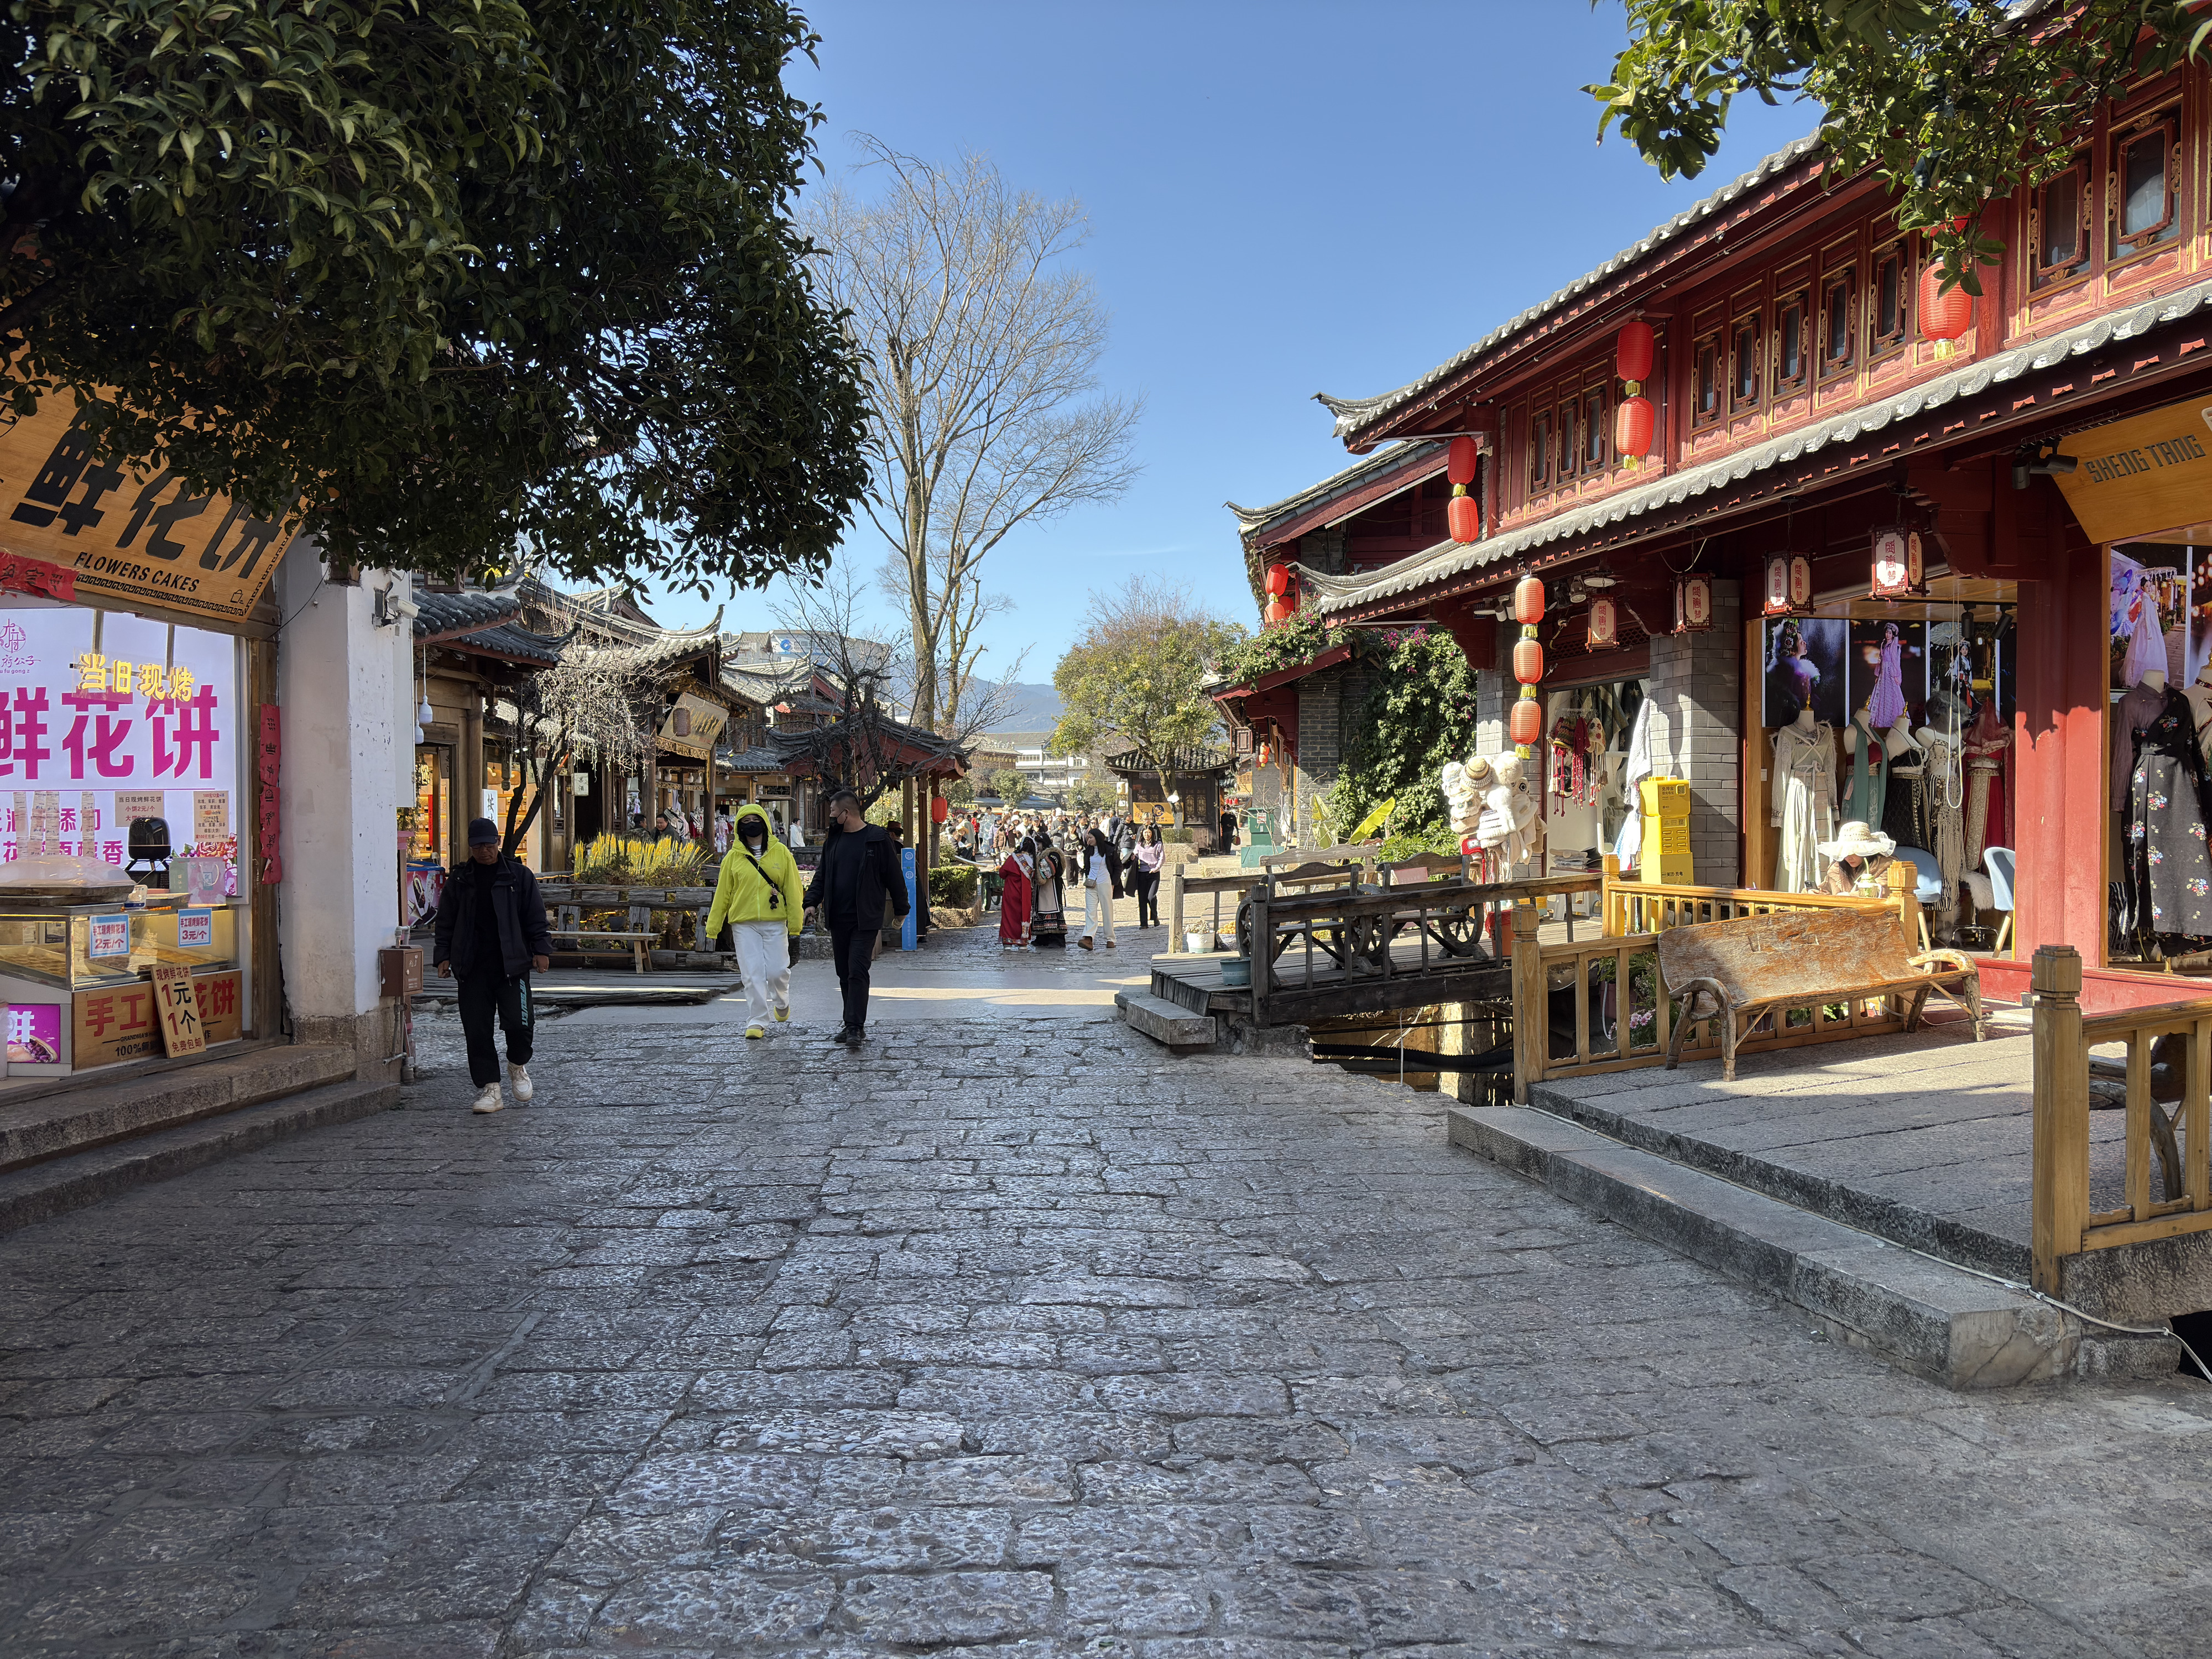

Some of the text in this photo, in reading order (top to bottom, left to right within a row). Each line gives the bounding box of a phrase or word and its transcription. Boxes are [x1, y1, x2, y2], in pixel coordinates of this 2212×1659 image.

[2084, 434, 2206, 483] SHENG TANG
[74, 551, 150, 581] FLOWERS
[152, 570, 200, 592] CAKES
[79, 653, 195, 702] 当日现烤
[0, 685, 220, 779] 鲜花饼
[93, 924, 126, 936] 手工现烤鲜花饼
[180, 916, 208, 928] 手工现烤鲜花饼
[95, 938, 124, 950] 2元/个
[182, 930, 207, 940] 3元/个
[155, 966, 189, 981] 现烤鲜花饼
[161, 982, 192, 1007] 1元
[168, 1010, 196, 1036] 1个
[171, 1037, 202, 1053] 免费包邮
